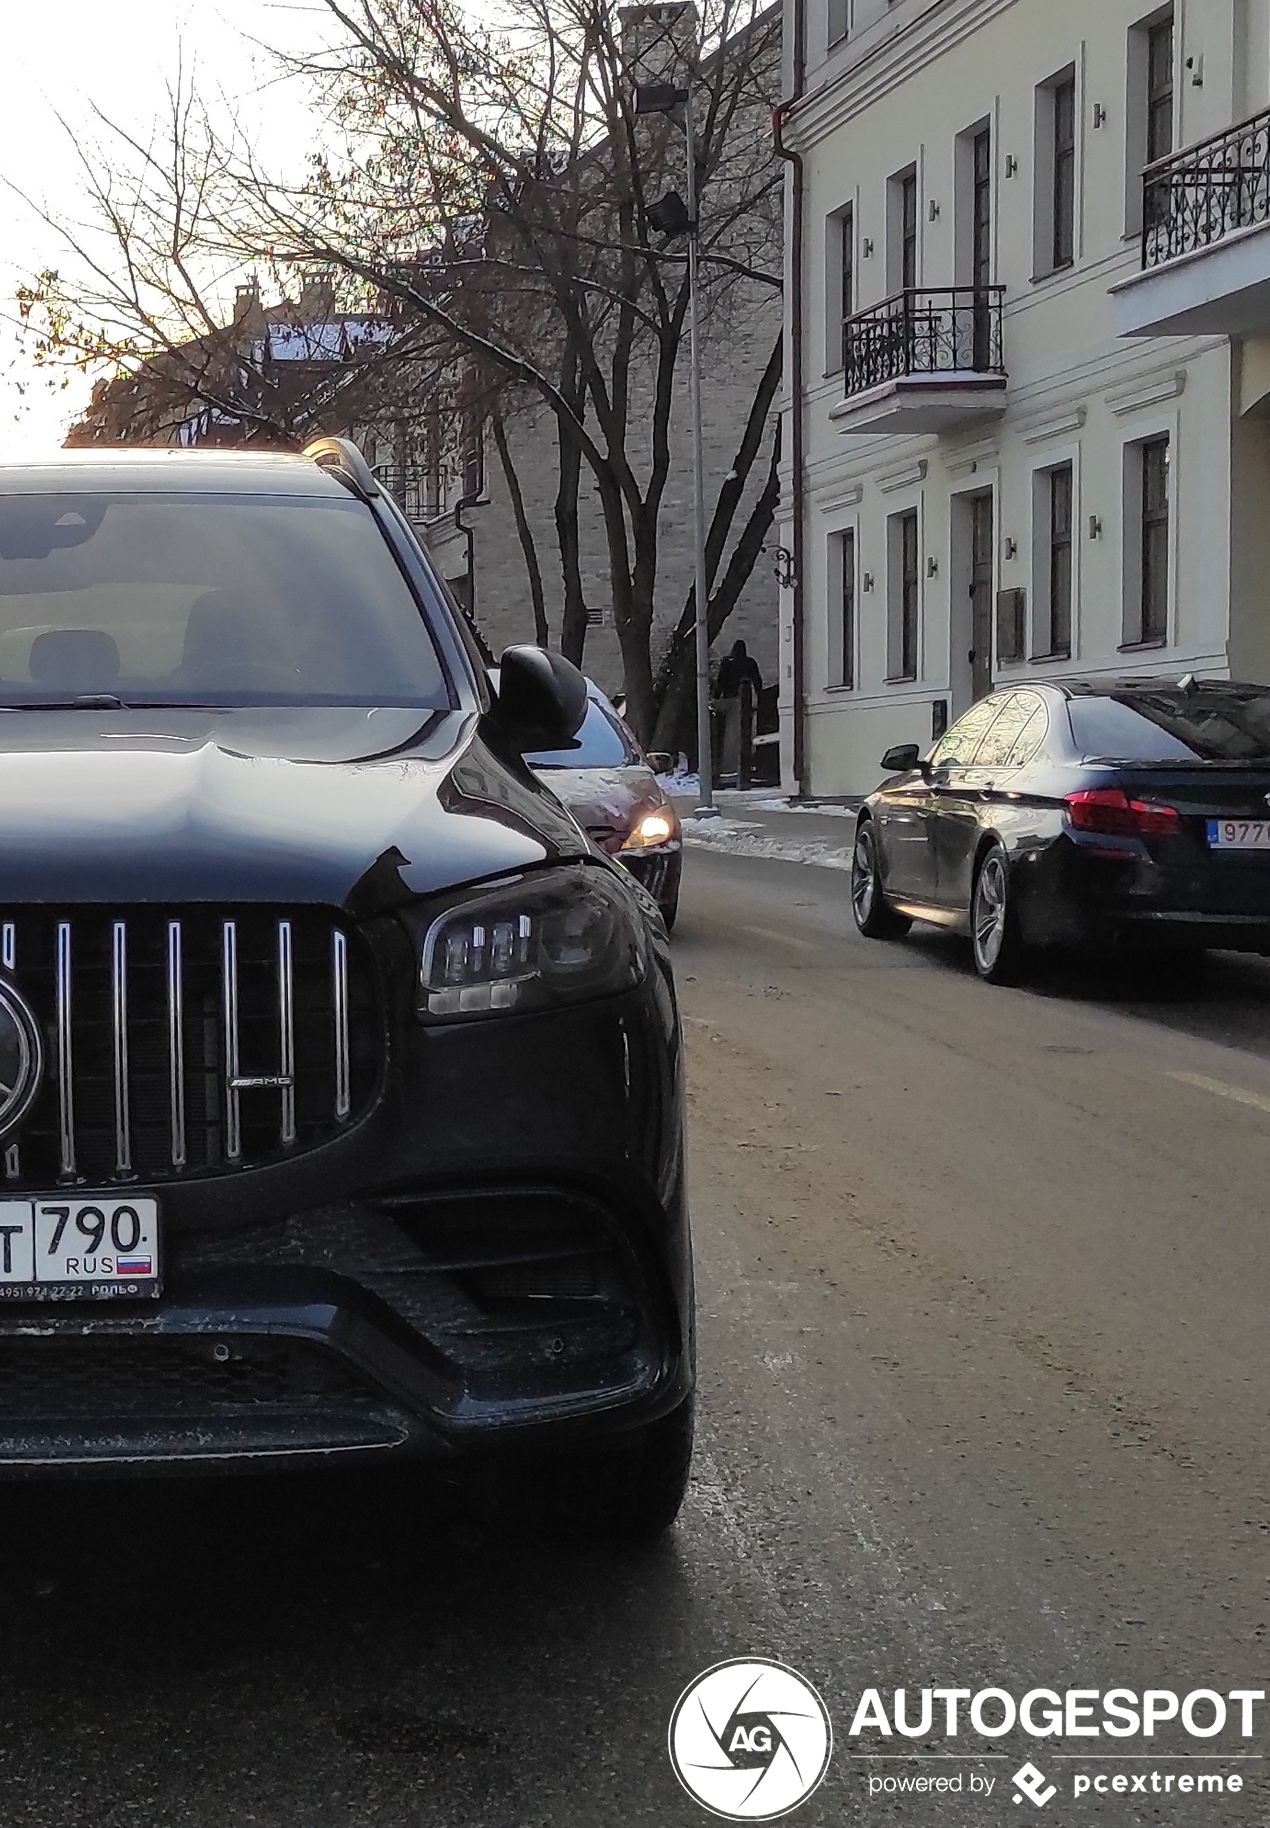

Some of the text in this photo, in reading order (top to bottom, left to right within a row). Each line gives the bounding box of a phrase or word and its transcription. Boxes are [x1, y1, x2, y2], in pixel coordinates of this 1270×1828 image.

[1225, 823, 1270, 842] 977
[251, 1077, 291, 1085] AMG
[41, 1205, 142, 1255] 790
[66, 1256, 114, 1275] RUS
